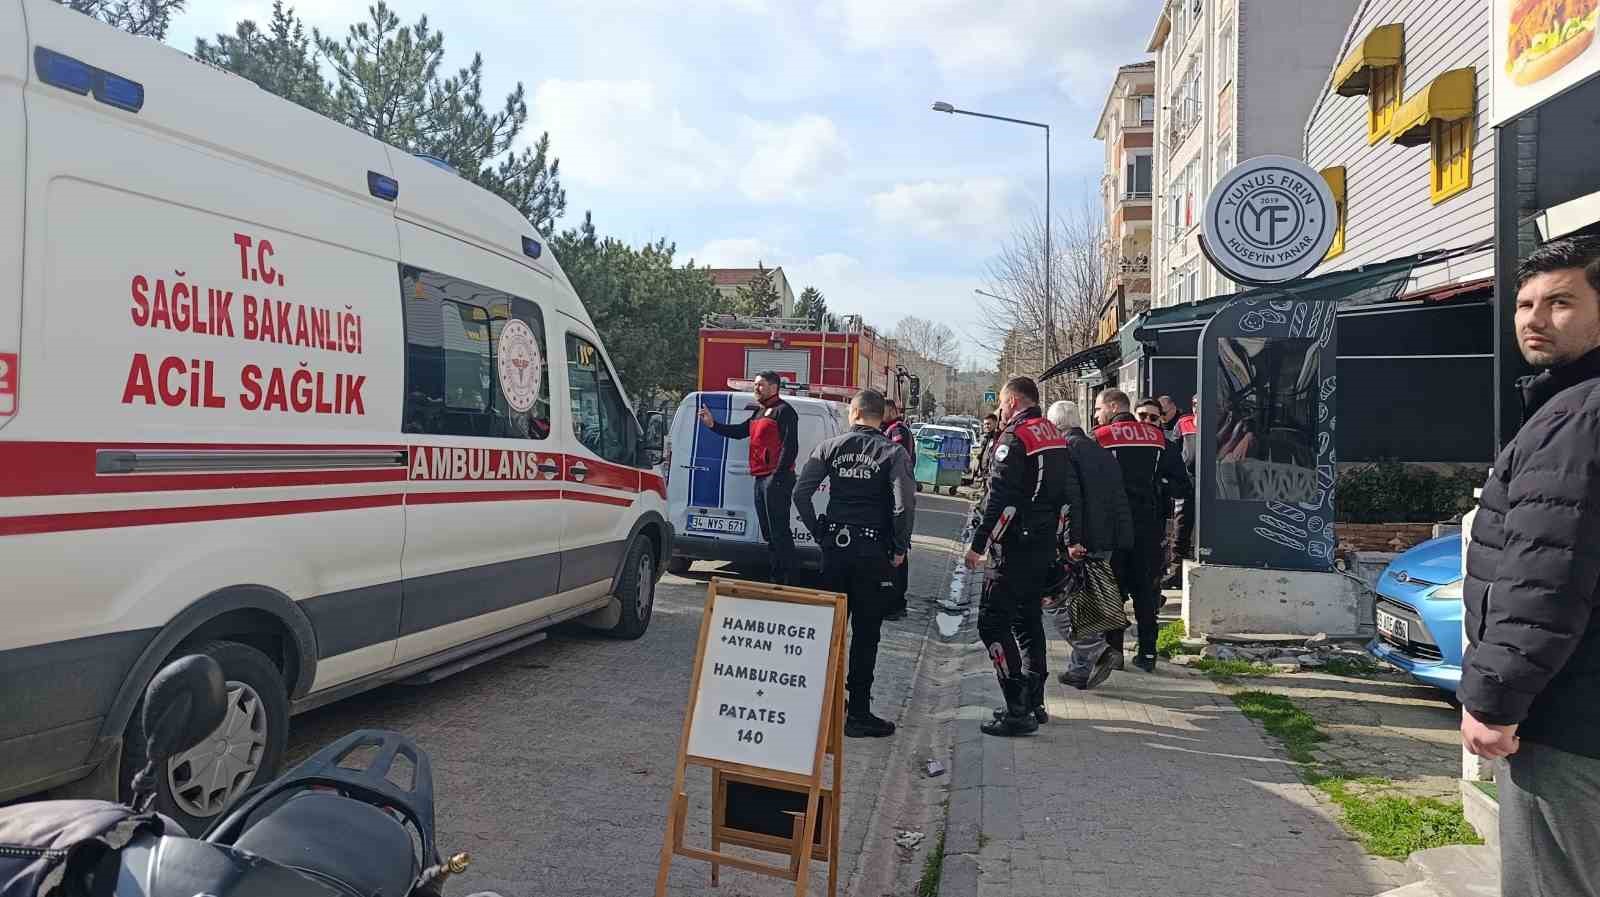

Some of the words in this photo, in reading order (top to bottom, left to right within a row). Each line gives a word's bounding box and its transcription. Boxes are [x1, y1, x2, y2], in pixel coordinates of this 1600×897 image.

[1225, 174, 1275, 207] YUNUS
[1279, 175, 1316, 206] FIRIN
[233, 232, 285, 287] T.C.
[1276, 235, 1314, 261] YANAR
[131, 269, 235, 338] SAĞLIK
[243, 294, 363, 354] BAKANLIĞI
[239, 361, 367, 416] SAĞLIK
[410, 446, 539, 481] AMBULANS
[707, 518, 723, 529] NYS
[728, 520, 744, 531] 671
[722, 617, 816, 640] HAMBURGER
[784, 644, 803, 656] 110
[713, 662, 807, 688] HAMBURGER
[719, 703, 787, 725] PATATES
[737, 729, 764, 744] 140
